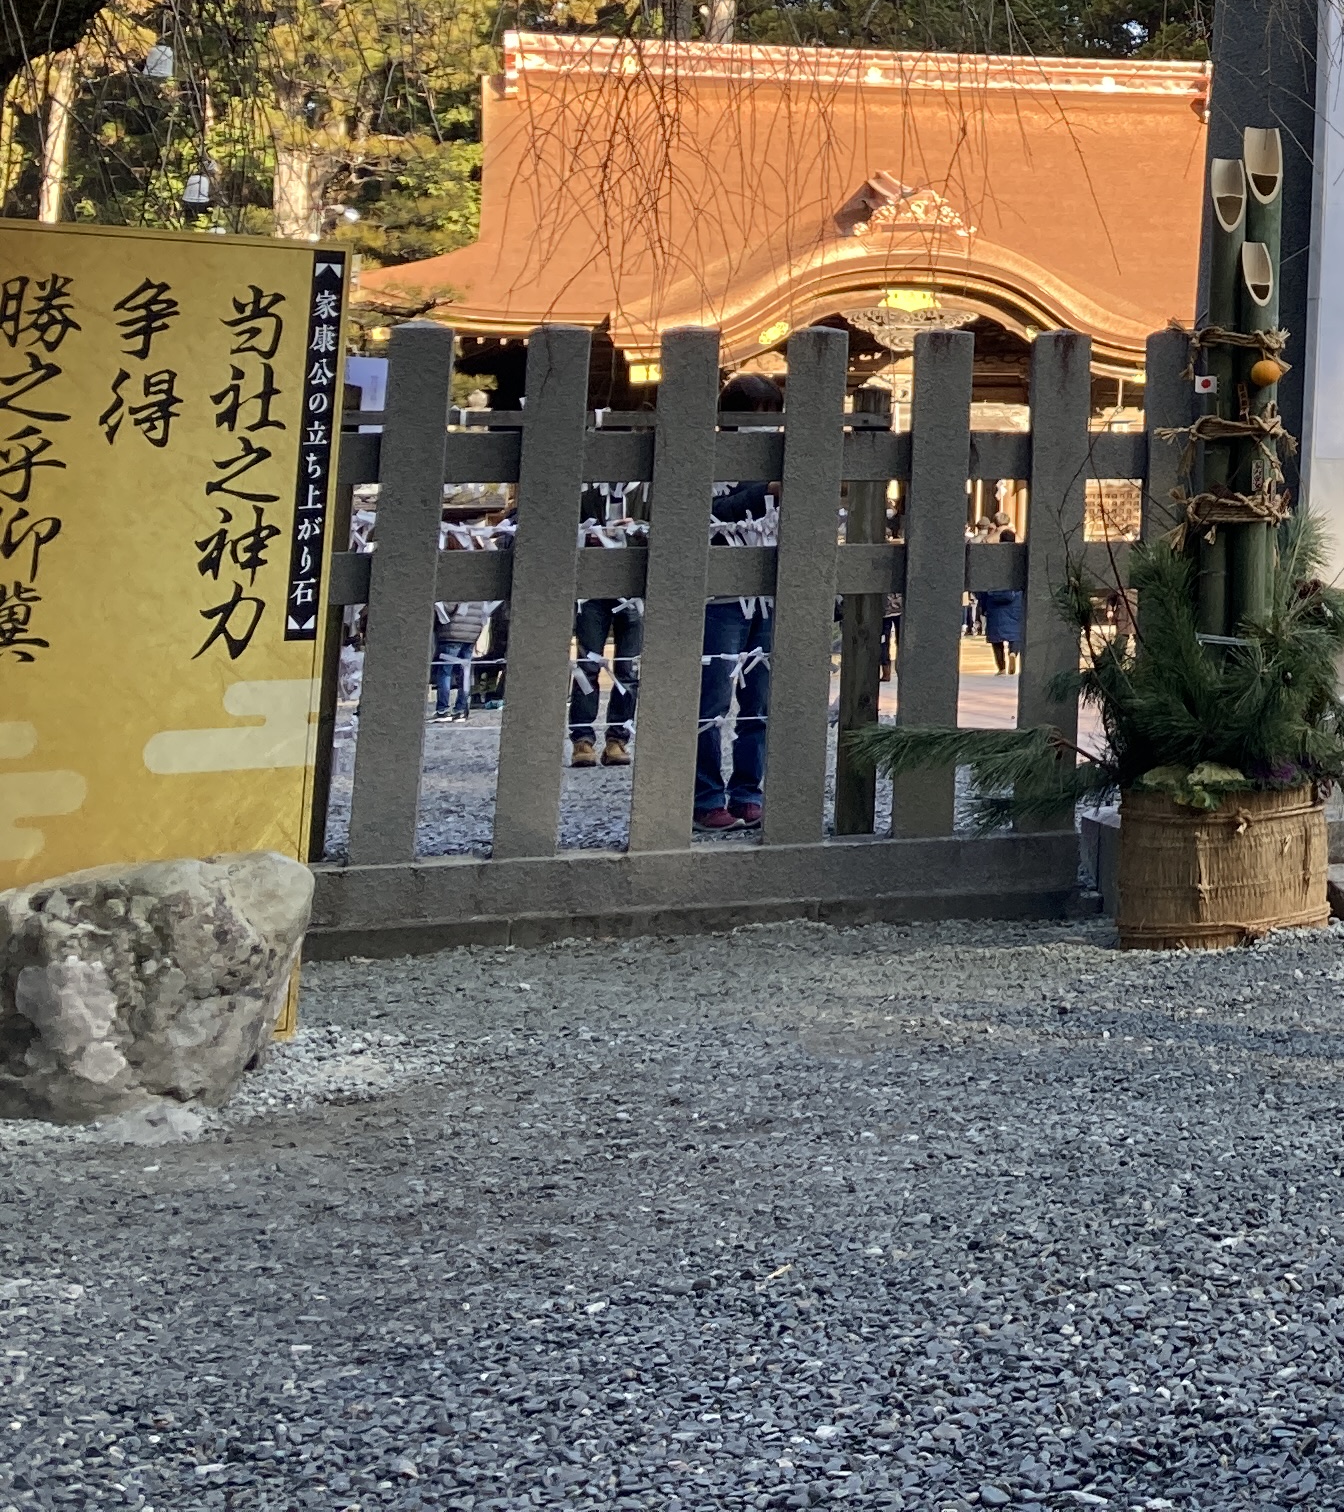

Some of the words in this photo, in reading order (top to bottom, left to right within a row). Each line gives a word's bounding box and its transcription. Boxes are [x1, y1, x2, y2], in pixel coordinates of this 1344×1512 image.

[98, 276, 183, 447] 争得
[191, 284, 287, 661] 当社之神力
[289, 288, 338, 606] 家康公の立ち上がり石
